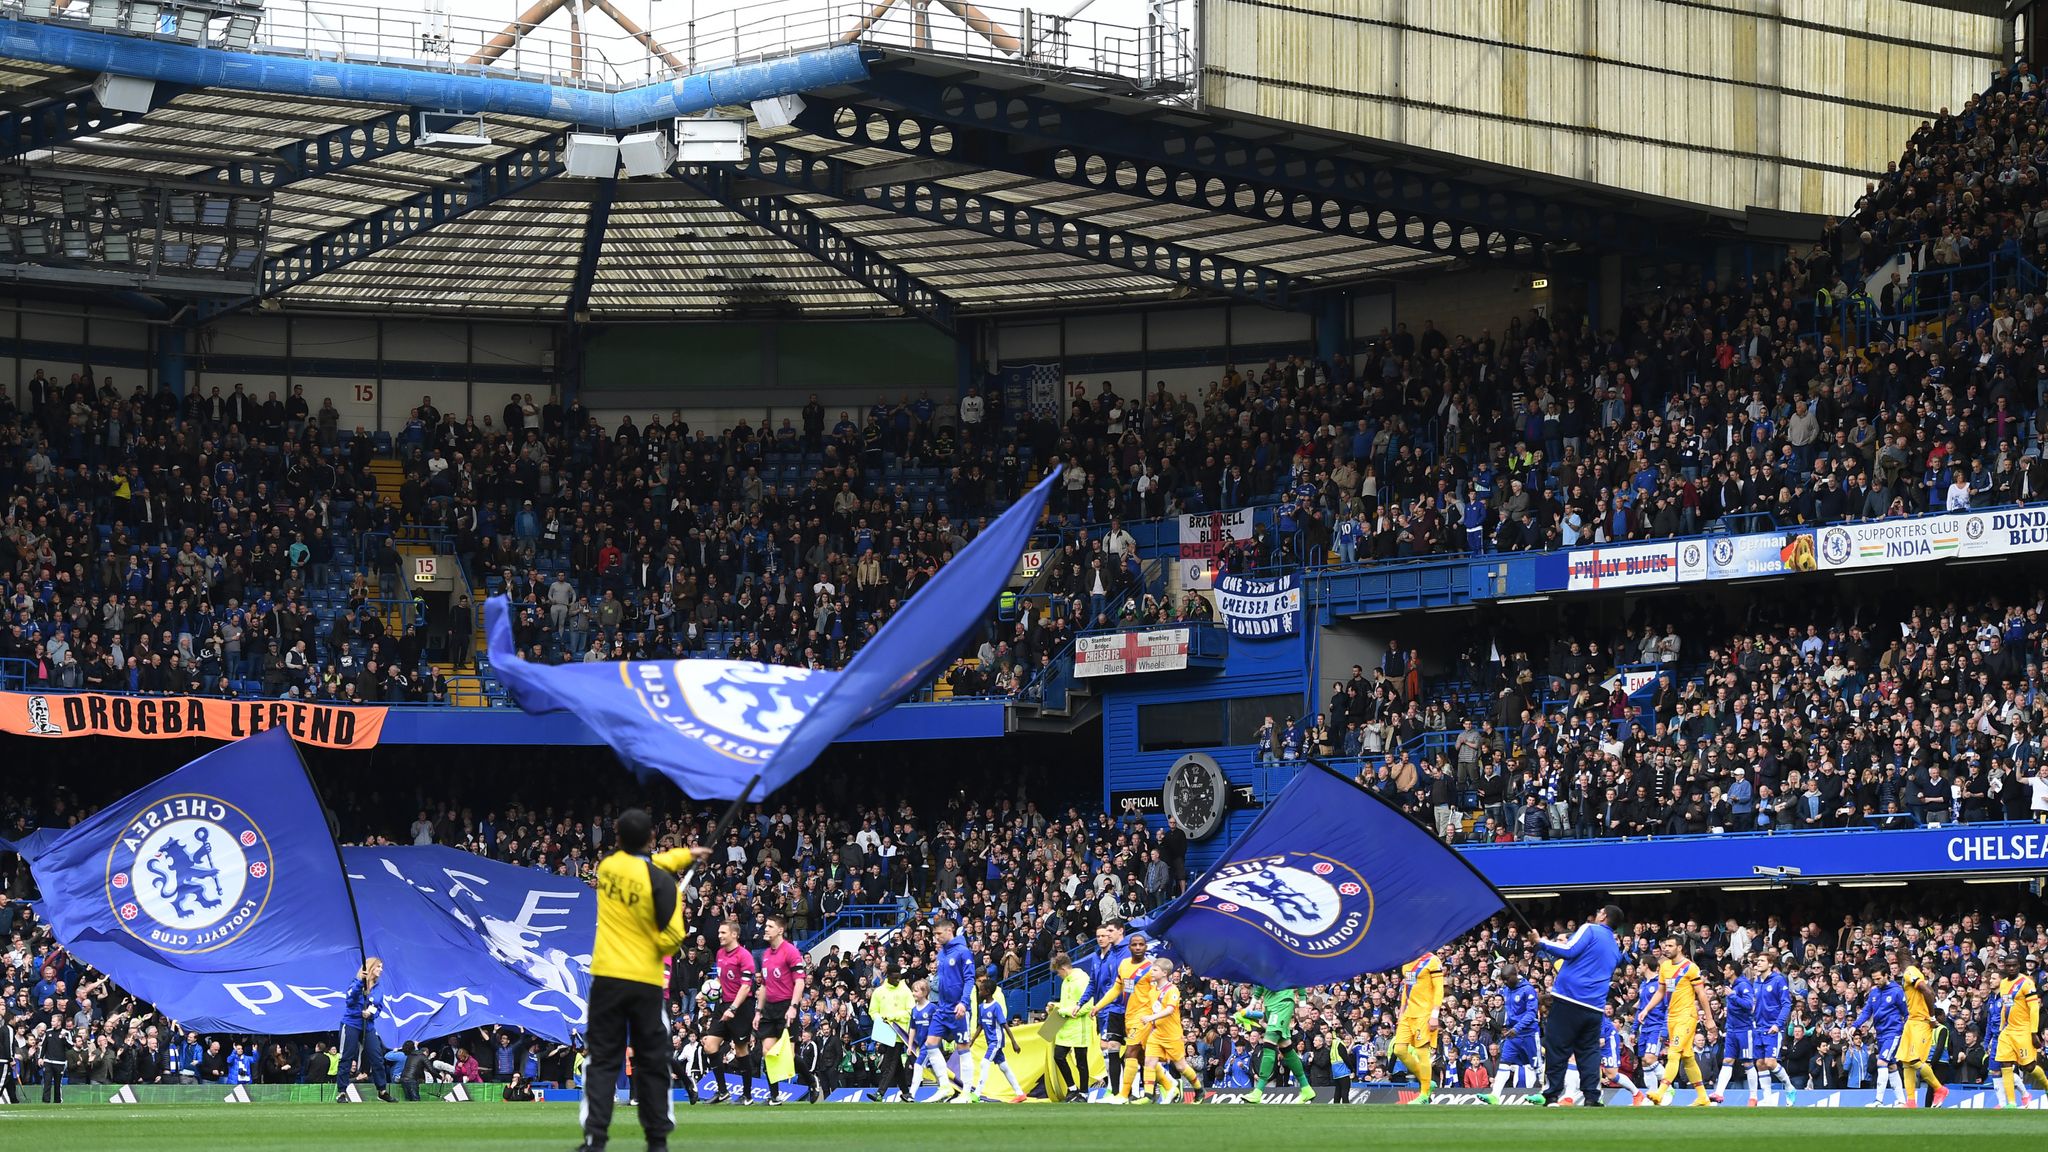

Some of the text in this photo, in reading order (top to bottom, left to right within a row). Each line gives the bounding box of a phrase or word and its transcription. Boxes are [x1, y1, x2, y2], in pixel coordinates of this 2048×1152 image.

[355, 385, 374, 402] 15
[1189, 512, 1245, 528] BRACKNELL
[1992, 511, 2048, 530] DUND
[1200, 529, 1232, 543] BLUES
[1341, 523, 1351, 536] 10
[1857, 524, 1927, 541] SUPPORTERS
[1930, 520, 1959, 535] CLUB
[1738, 536, 1787, 551] German
[1886, 539, 1931, 558] INDIA
[418, 559, 434, 573] 15
[1024, 554, 1040, 568] 16
[1574, 558, 1621, 579] PHILLY
[1625, 554, 1668, 575] BLUES
[1747, 560, 1782, 573] Blues
[1222, 575, 1291, 594] ONE TEAM IN
[1222, 595, 1289, 615] CHELSEA FC
[1232, 618, 1279, 635] LONDON
[1091, 636, 1112, 644] Stamford
[1148, 634, 1170, 642] Wembley
[1085, 649, 1120, 662] CHELSEA FC
[1151, 644, 1179, 656] ENGLAND
[1103, 664, 1124, 673] Blues
[1138, 660, 1165, 670] Wheels
[63, 697, 356, 745] DROGBA LEGEND
[957, 1032, 970, 1043] 24
[1646, 1043, 1657, 1053] 28
[1772, 1047, 1777, 1057] 3
[1602, 1056, 1613, 1067] 30
